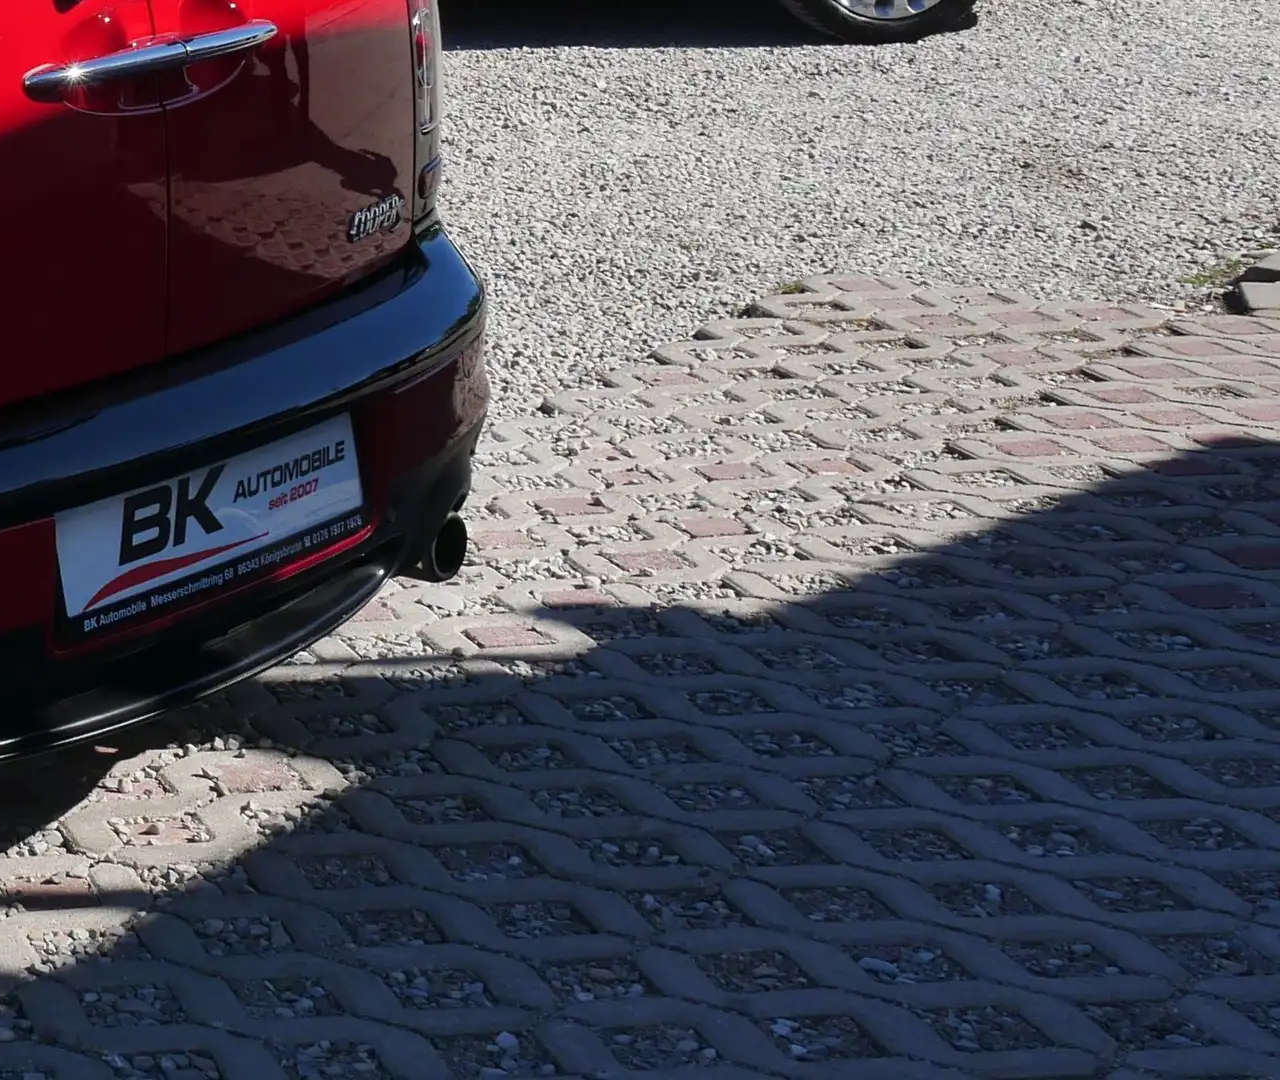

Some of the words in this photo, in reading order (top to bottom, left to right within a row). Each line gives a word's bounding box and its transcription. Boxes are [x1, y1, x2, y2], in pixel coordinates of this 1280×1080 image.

[232, 439, 346, 504] AUTOMOBILE
[268, 491, 289, 511] seit
[289, 477, 320, 502] 2007
[118, 462, 228, 567] BK
[83, 617, 99, 632] BK
[99, 599, 147, 626] Automobile
[150, 573, 224, 607] Messerschmittring
